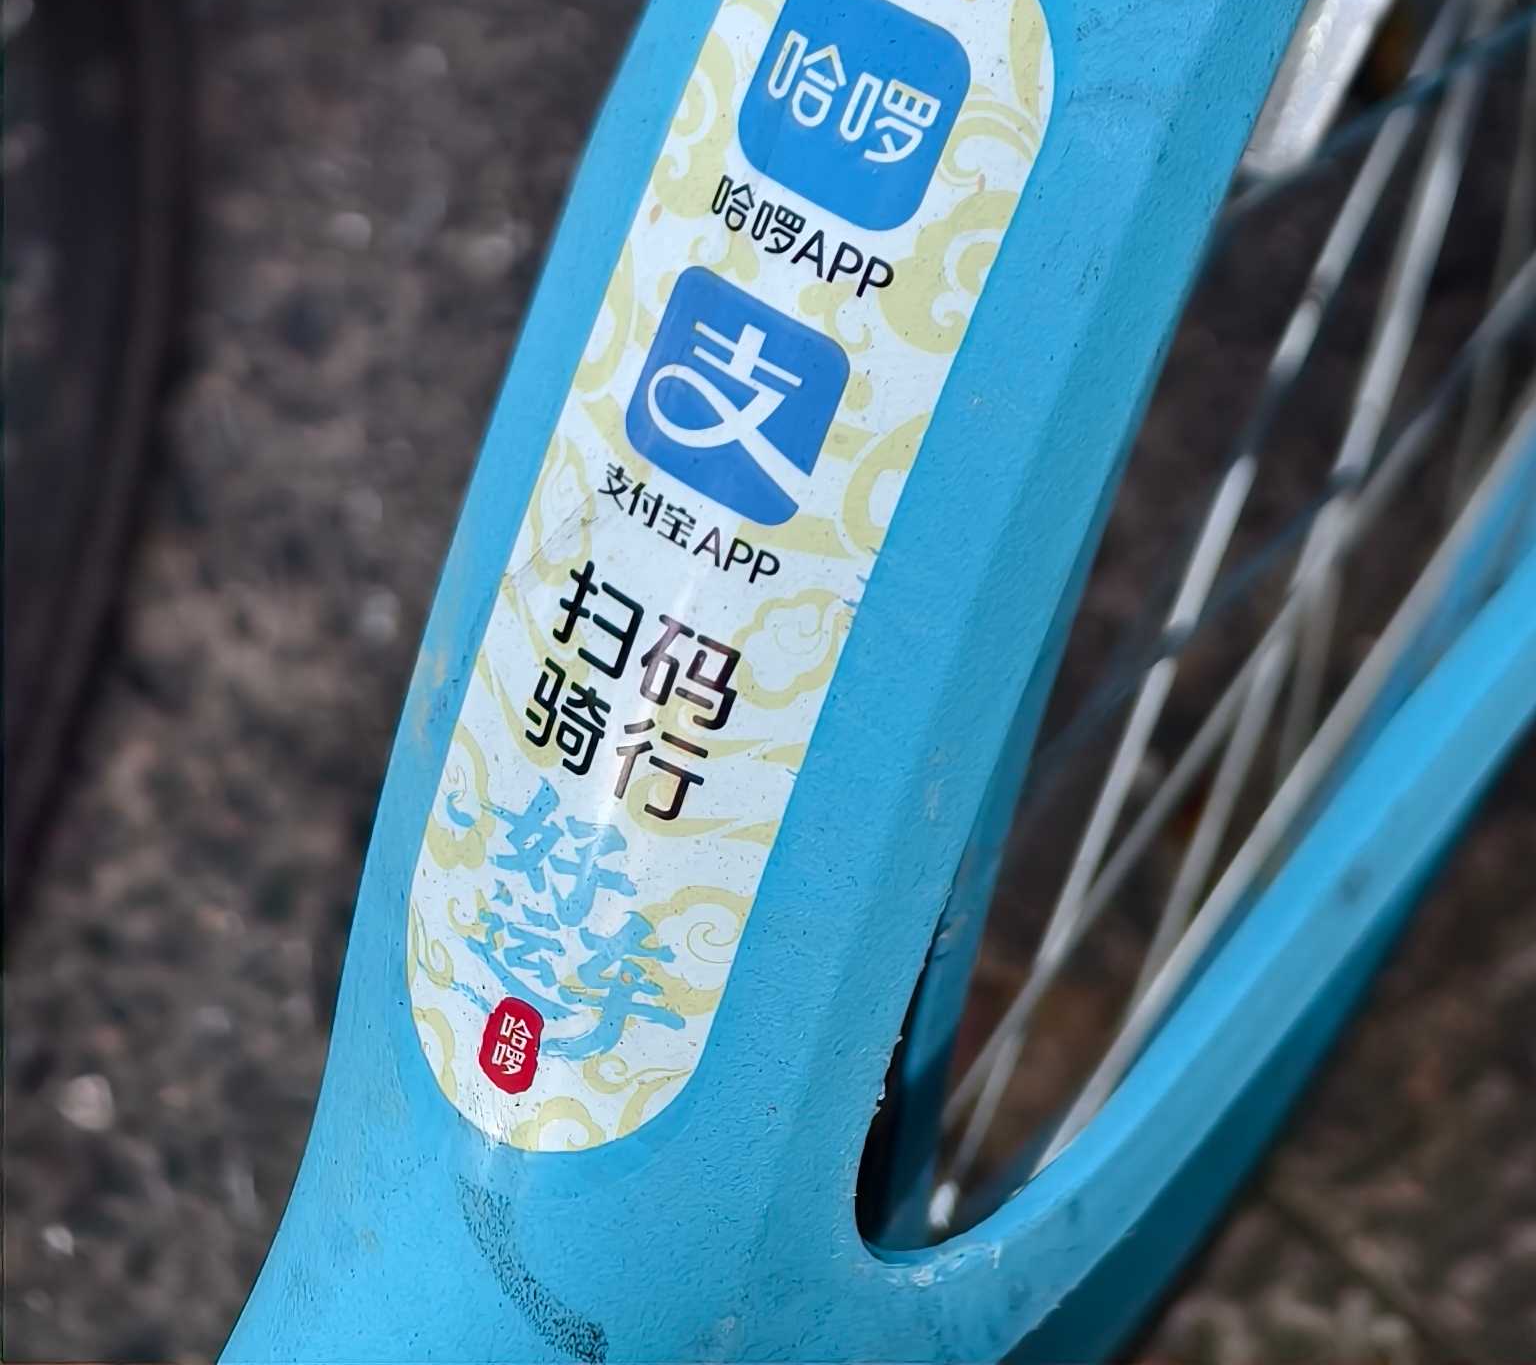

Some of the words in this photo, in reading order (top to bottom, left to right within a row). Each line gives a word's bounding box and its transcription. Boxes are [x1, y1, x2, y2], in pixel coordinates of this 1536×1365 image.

[766, 29, 942, 164] 哈啰
[711, 173, 895, 299] 哈啰APP
[552, 559, 742, 731] 扫码
[524, 657, 709, 821] 骑行
[490, 1010, 536, 1076] 哈啰
